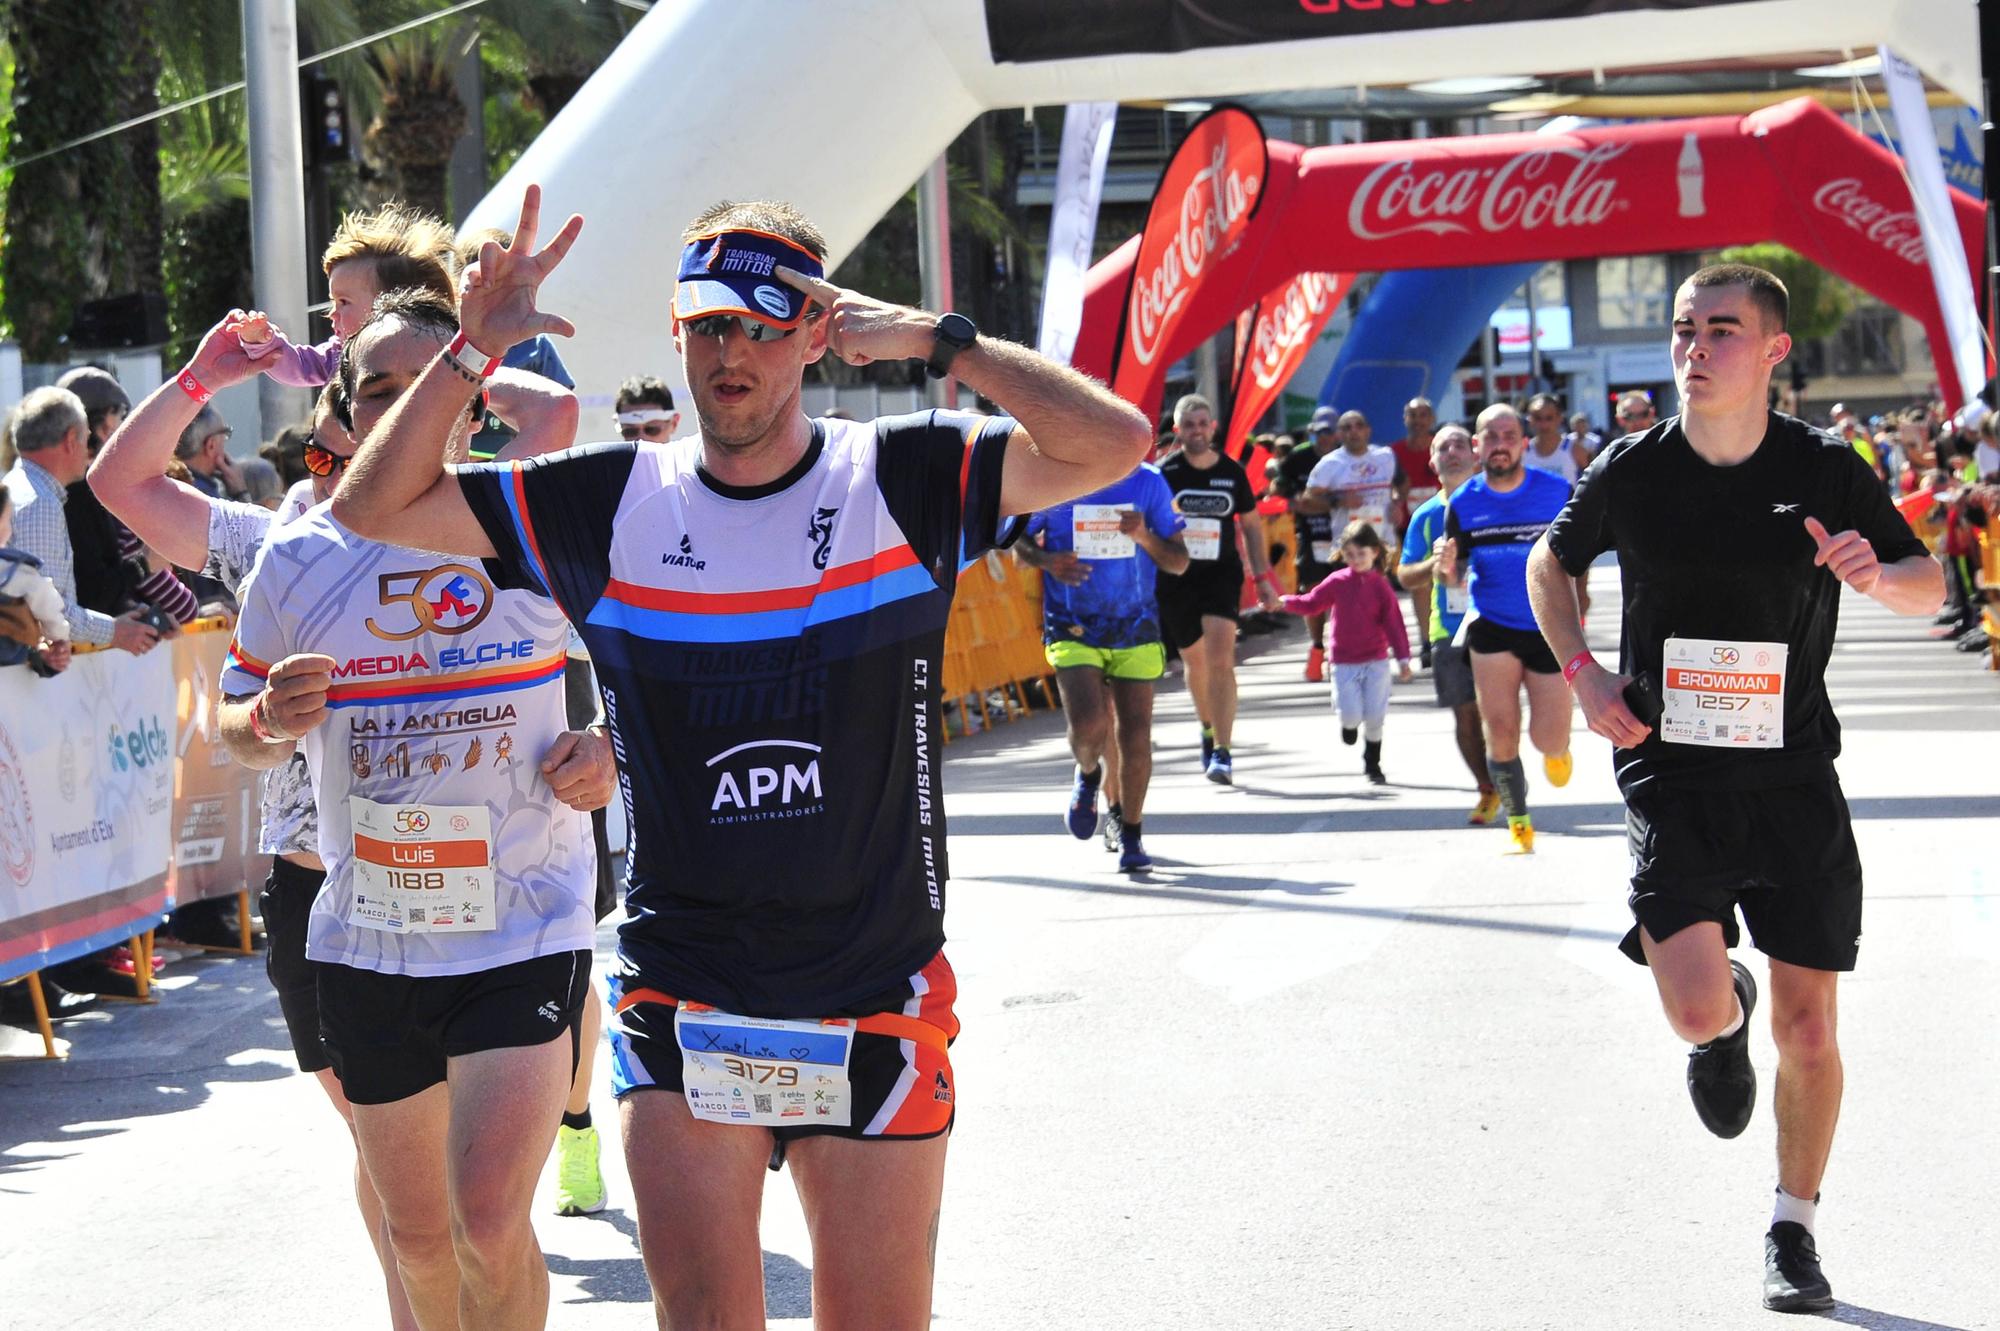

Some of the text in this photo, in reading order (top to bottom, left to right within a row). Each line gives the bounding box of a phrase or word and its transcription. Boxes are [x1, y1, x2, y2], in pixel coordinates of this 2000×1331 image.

[1348, 140, 1632, 239] Coca-Cola
[1813, 177, 1928, 265] Coca-Cola
[725, 248, 777, 266] TRAVESIAS
[1131, 136, 1247, 366] Coca-Cola
[721, 257, 772, 276] MITOS
[662, 552, 706, 571] VIATOR
[365, 563, 494, 642] 50
[332, 639, 535, 679] MEDIA ELCHE
[1709, 646, 1740, 665] 50
[1678, 672, 1769, 690] BROWMAN
[1695, 694, 1750, 711] 1257
[350, 716, 379, 733] LA
[402, 703, 517, 732] ANTIGUA
[128, 714, 168, 769] elche
[711, 759, 823, 811] APM
[914, 658, 941, 910] C.T. TRAVESIAS MITOS
[393, 810, 430, 833] 50
[710, 804, 824, 825] ADMINISTRADORES
[387, 870, 444, 890] 1188
[724, 1058, 799, 1087] 3179
